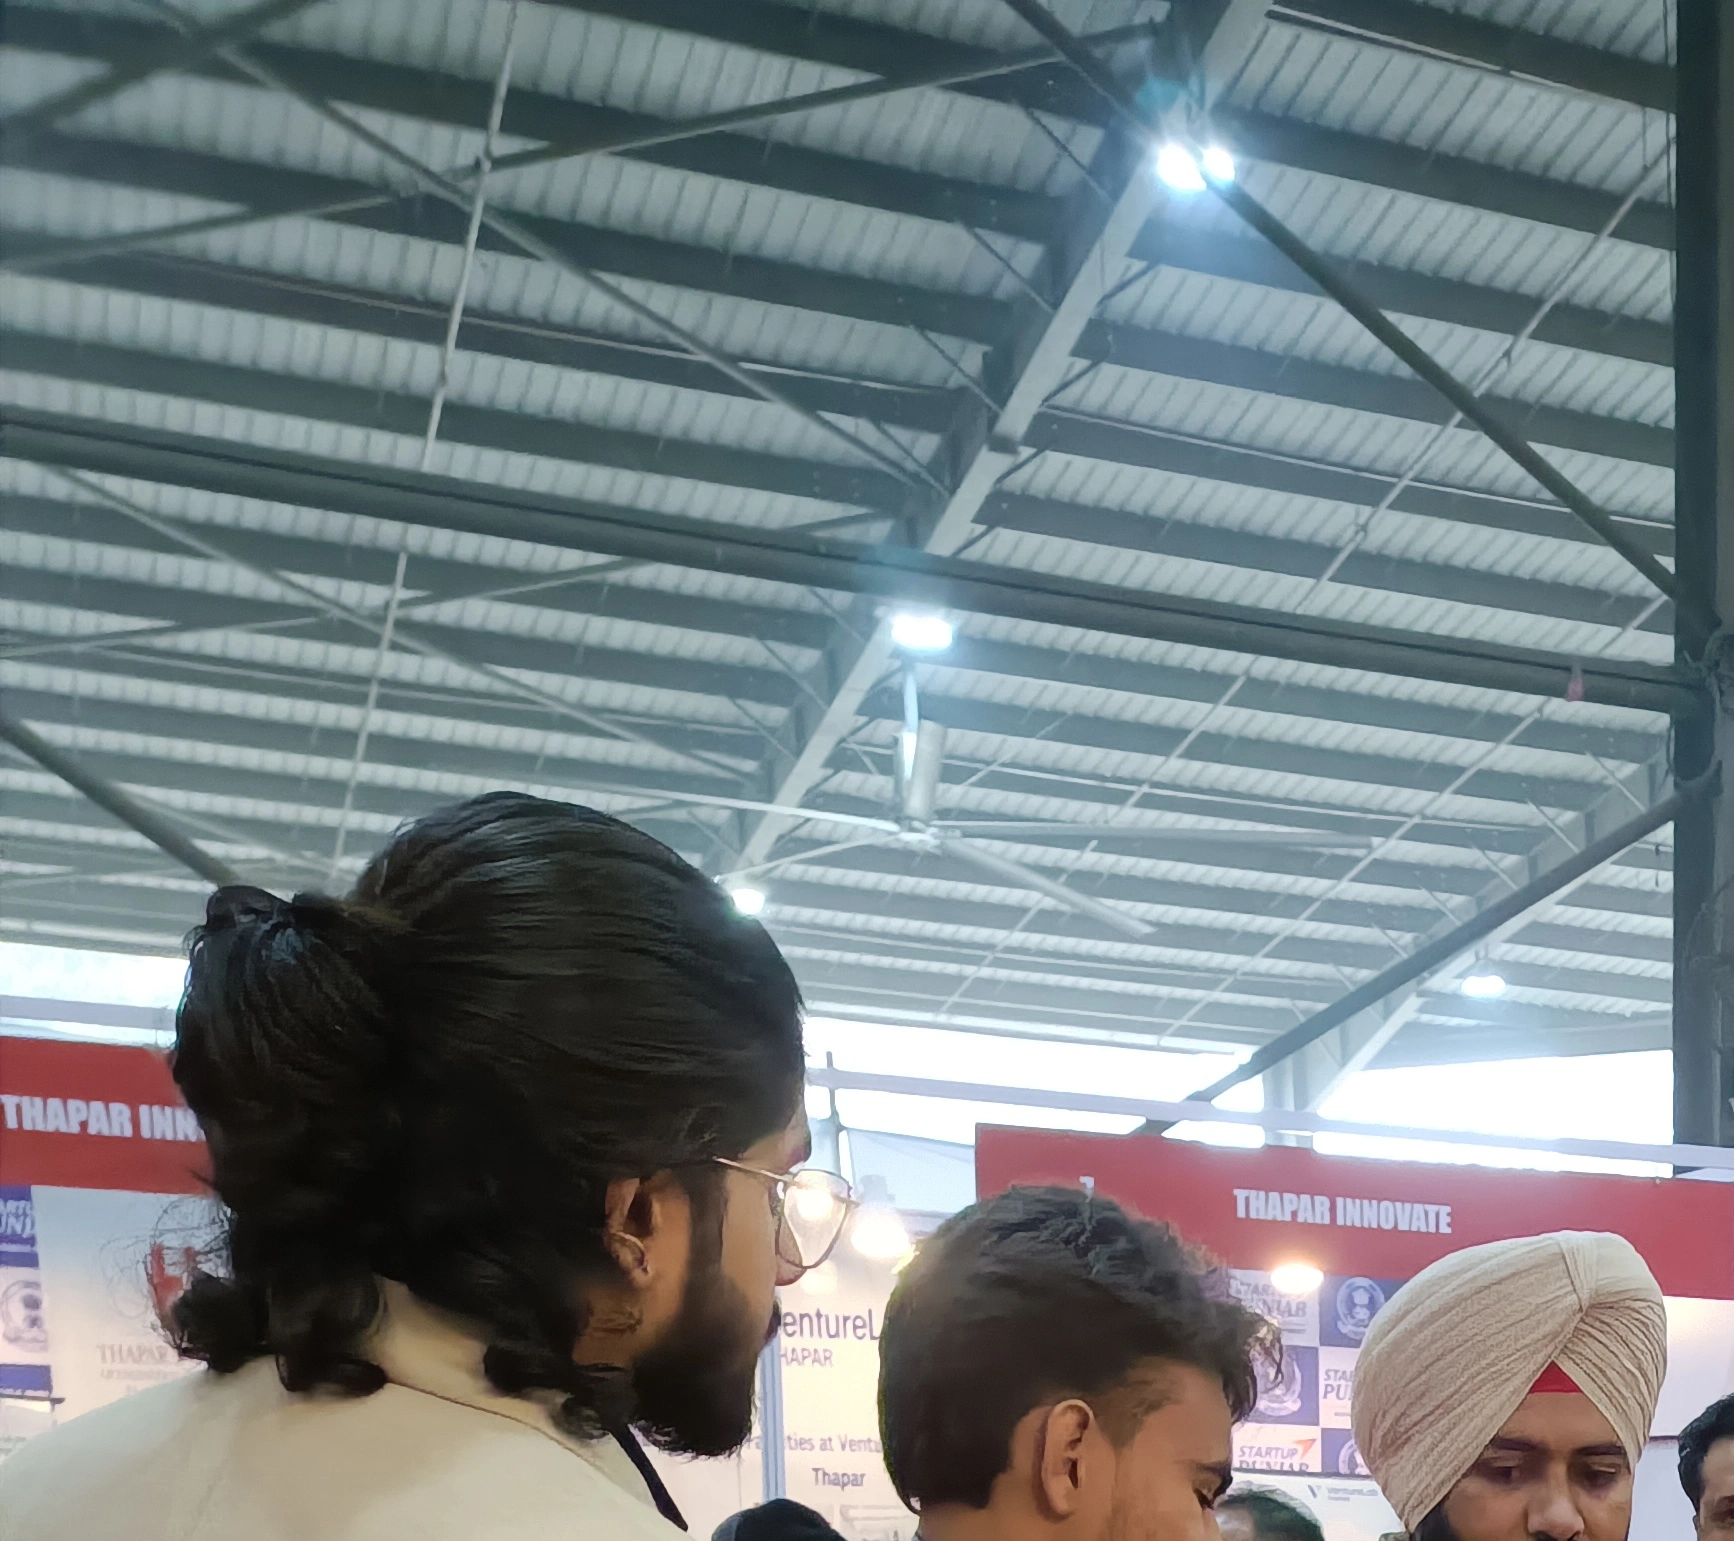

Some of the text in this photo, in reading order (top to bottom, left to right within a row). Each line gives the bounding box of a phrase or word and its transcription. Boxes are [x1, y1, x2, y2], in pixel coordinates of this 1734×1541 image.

[1, 1095, 207, 1142] THAPAR INN
[1233, 1188, 1452, 1234] THAPAR INNOVATE
[1238, 1446, 1300, 1459] STARTUP
[811, 1467, 867, 1491] Thapar
